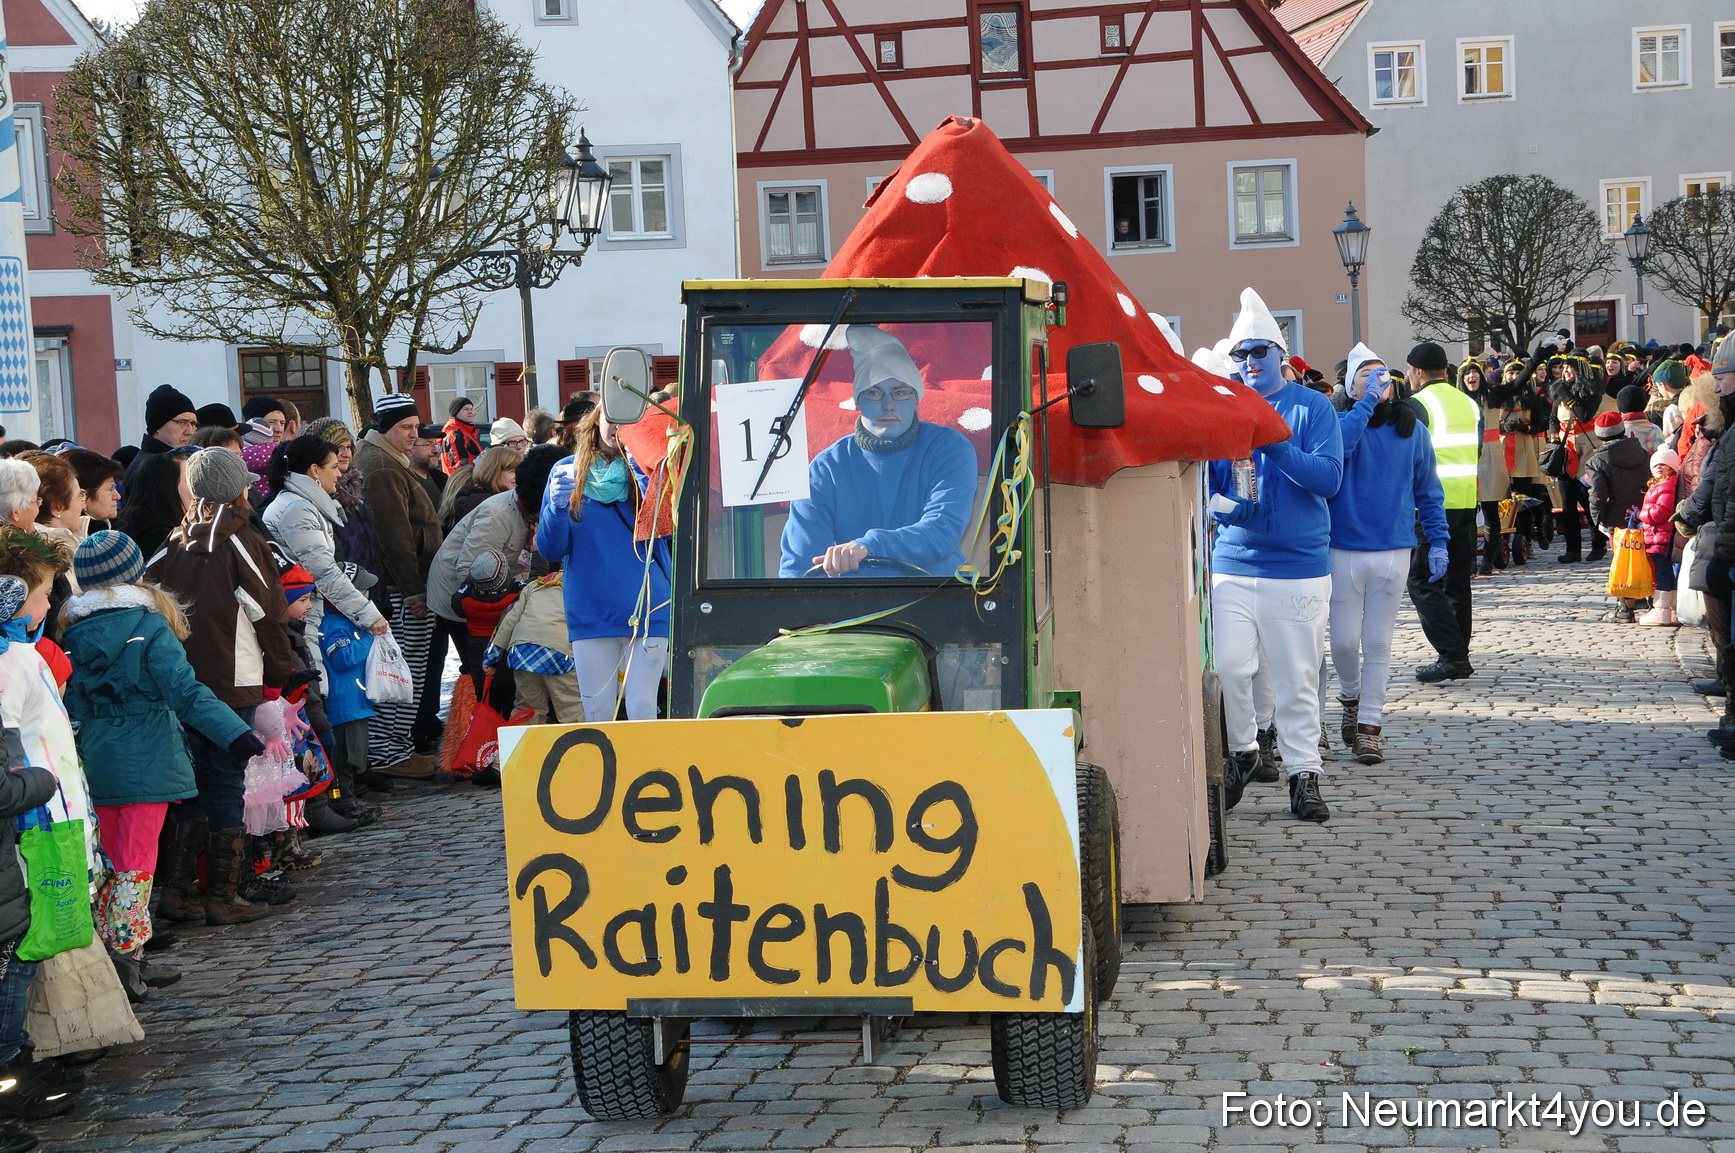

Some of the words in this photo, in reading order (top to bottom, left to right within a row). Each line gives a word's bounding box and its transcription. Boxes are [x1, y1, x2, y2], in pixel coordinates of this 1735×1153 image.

[739, 416, 792, 462] 15
[537, 728, 979, 893] Oening
[40, 878, 73, 888] ACUNA
[516, 852, 1077, 1006] Raitenbuch
